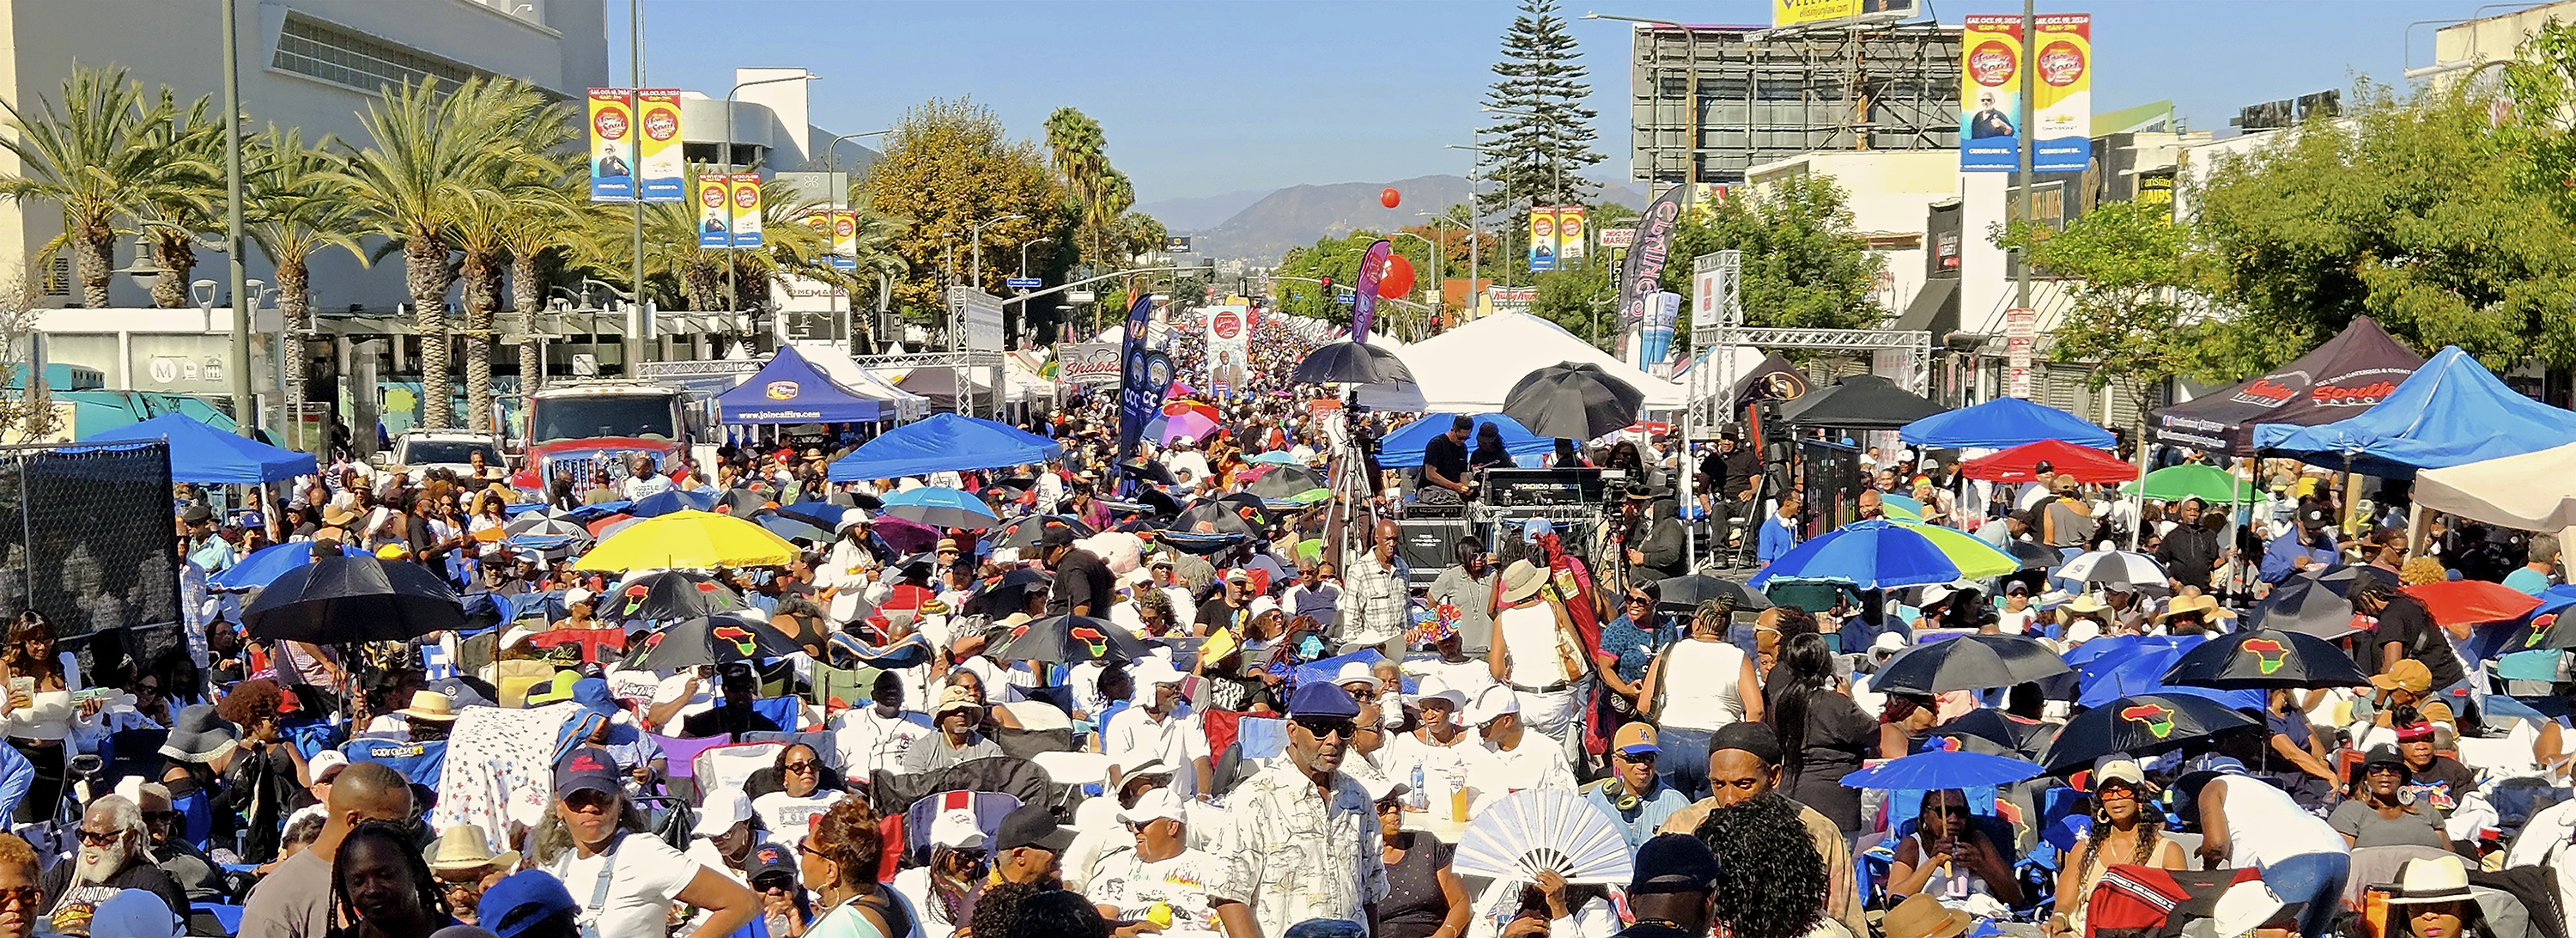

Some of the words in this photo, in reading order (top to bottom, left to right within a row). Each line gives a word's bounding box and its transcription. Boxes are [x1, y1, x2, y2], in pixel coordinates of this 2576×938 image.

[1639, 728, 1650, 740] LA
[371, 748, 391, 757] BODY
[391, 746, 414, 757] GLOVE
